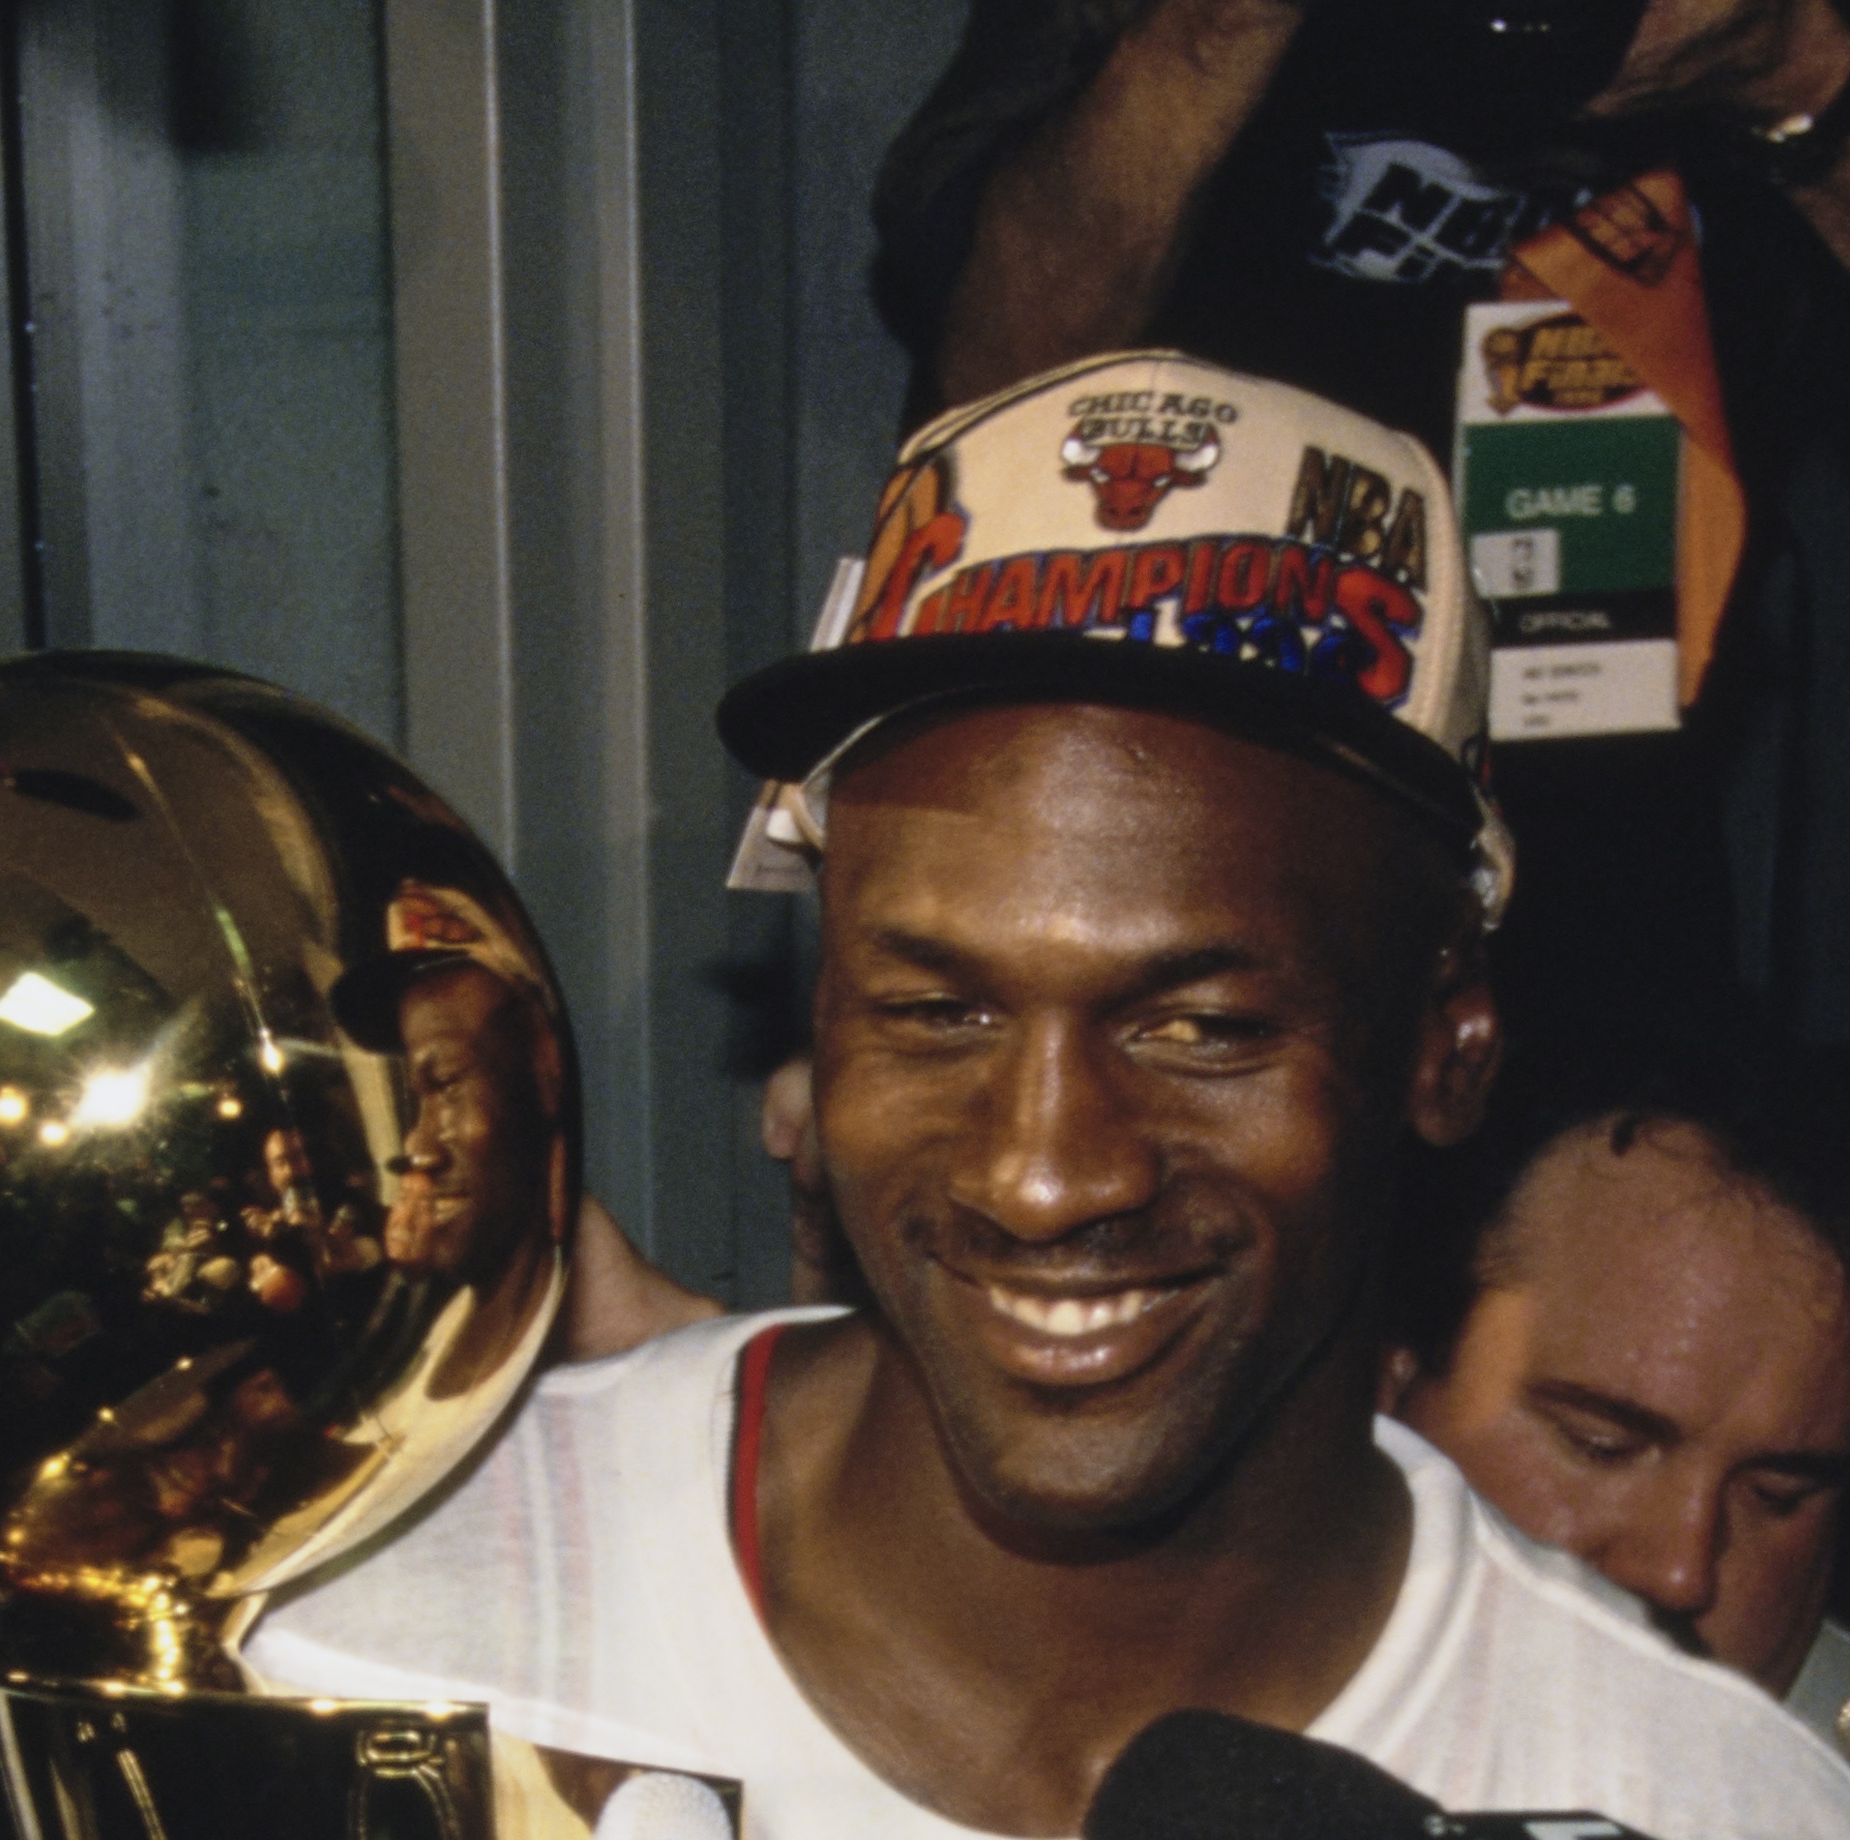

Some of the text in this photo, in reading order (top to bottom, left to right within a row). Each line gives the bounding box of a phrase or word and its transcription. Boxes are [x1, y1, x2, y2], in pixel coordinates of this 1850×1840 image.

[1067, 391, 1239, 425] CHICAGO
[1079, 416, 1211, 447] BULLS
[1286, 443, 1429, 592] NBA
[1505, 482, 1638, 521] GAME 6
[866, 510, 1424, 700] CHAMPIONS
